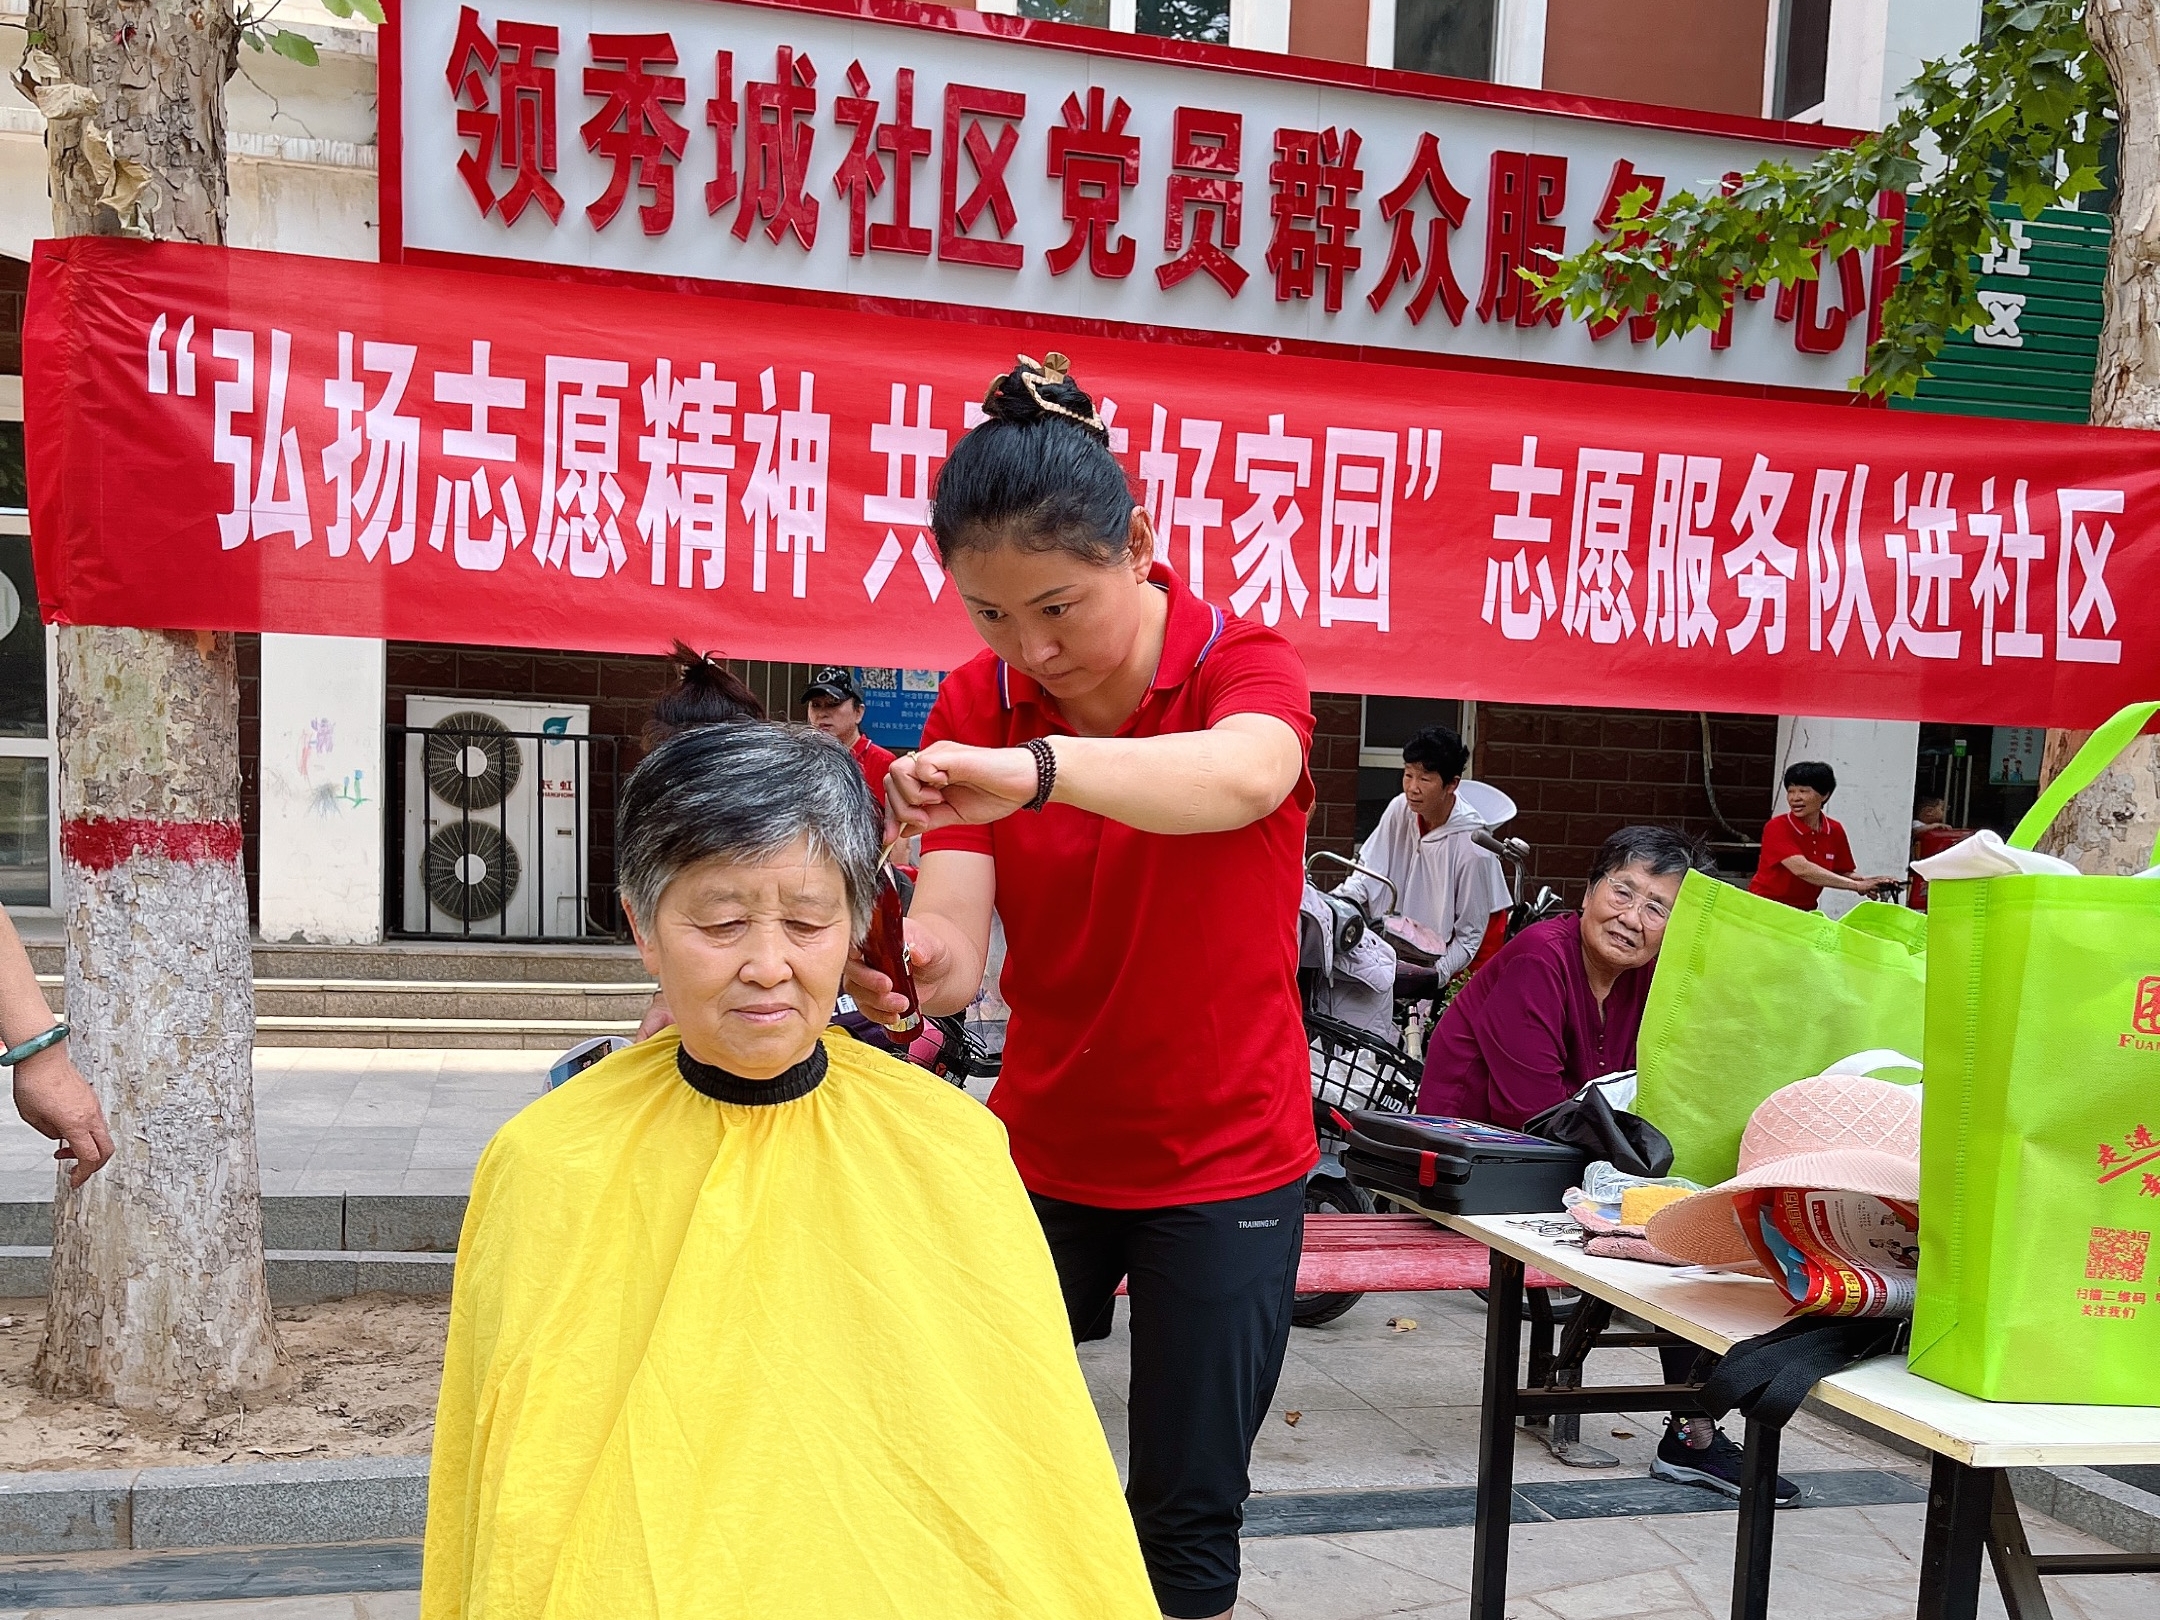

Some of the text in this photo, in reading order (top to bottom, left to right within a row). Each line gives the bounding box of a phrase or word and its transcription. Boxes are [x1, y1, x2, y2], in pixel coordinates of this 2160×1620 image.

[445, 5, 1866, 353] 领秀城社区党员群众服务心
[147, 312, 2125, 666] “弘扬志愿精神 共好家园” 志愿服务队进社区
[2077, 1288, 2146, 1305] 扫描二维码
[2082, 1304, 2136, 1319] 关注我们
